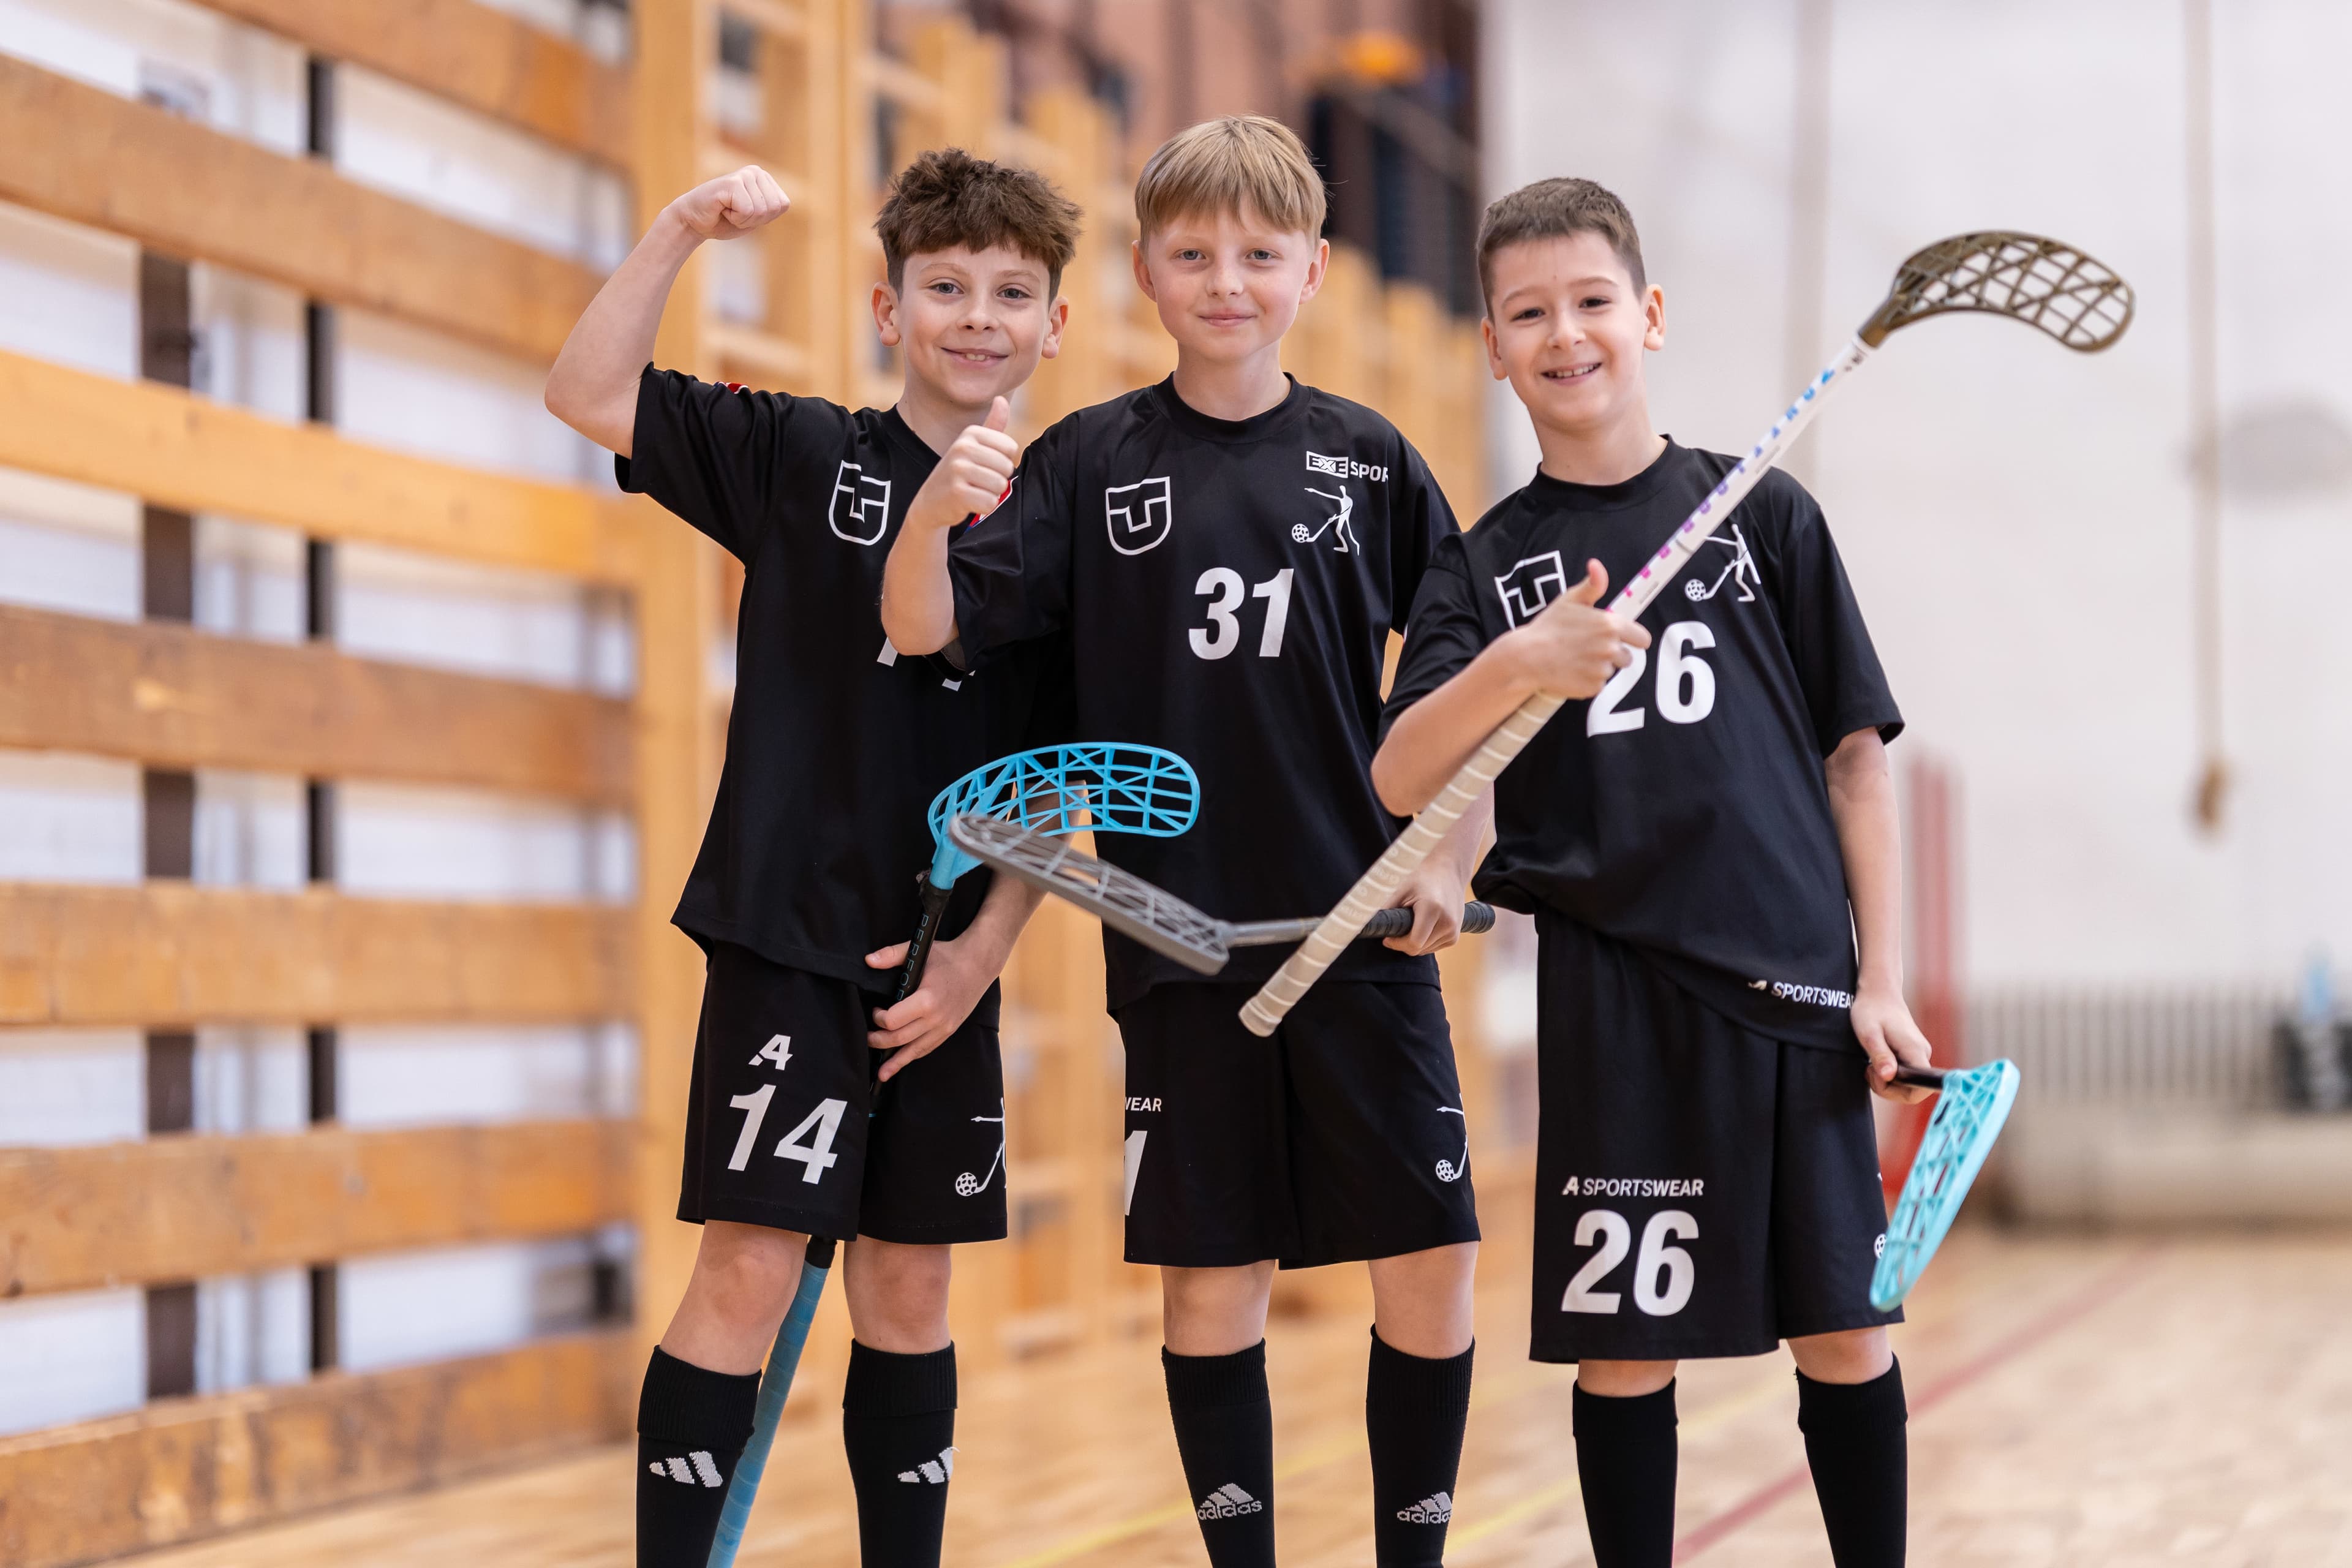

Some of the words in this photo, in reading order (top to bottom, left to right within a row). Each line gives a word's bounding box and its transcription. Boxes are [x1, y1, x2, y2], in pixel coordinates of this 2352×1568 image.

[1188, 567, 1294, 660] 31
[1587, 620, 1716, 738] 26
[728, 1084, 848, 1185] 14
[1582, 1177, 1705, 1197] SPORTSWEAR
[1561, 1209, 1700, 1317] 26
[1197, 1500, 1262, 1520] adidas
[1396, 1509, 1451, 1524] adida
